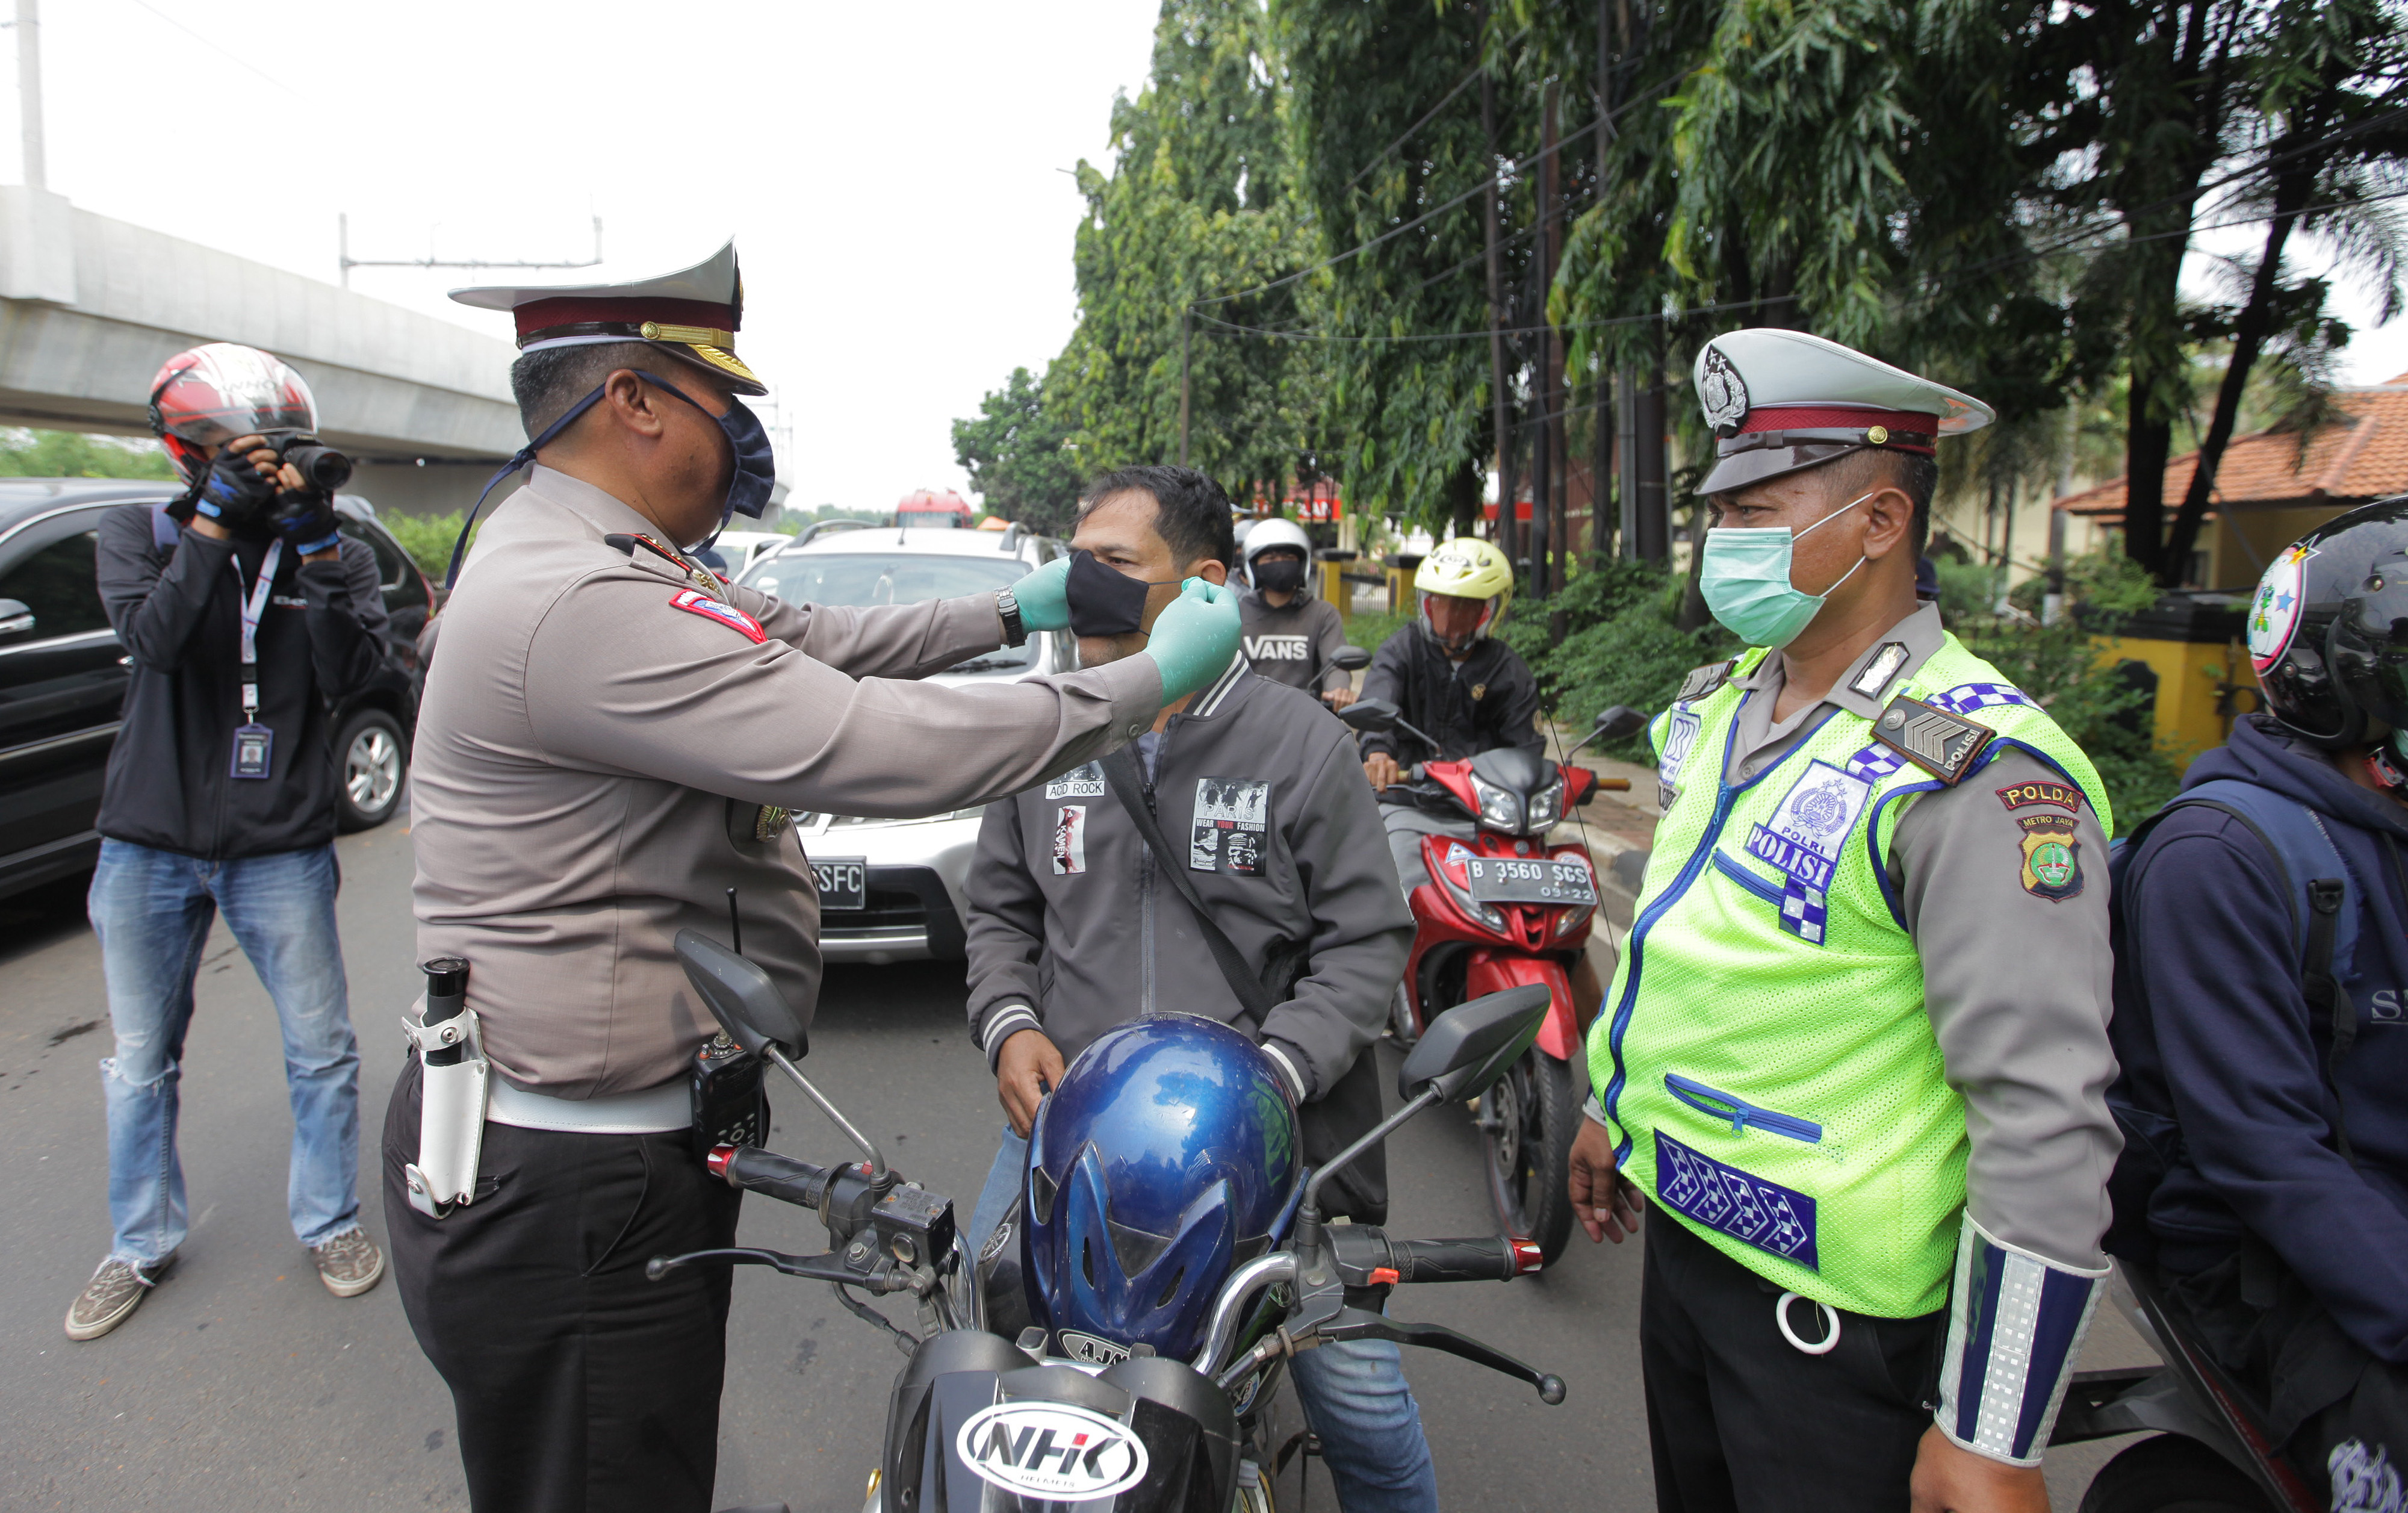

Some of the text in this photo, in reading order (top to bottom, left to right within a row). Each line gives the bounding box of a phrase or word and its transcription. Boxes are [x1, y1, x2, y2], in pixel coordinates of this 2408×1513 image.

[1243, 634, 1309, 660] VANS
[1944, 729, 1981, 771] POLISI
[1073, 782, 1103, 794] ROCK
[2006, 784, 2076, 808] POLDA
[1203, 804, 1255, 820] PARIS
[2023, 816, 2073, 827] METRO JAYA
[1196, 818, 1265, 833] WEAR YOUR FASHION
[1057, 825, 1067, 859] KAMEN
[1781, 826, 1825, 855] POLRI
[1747, 825, 1831, 888] POLISI
[819, 865, 861, 893] SFC
[1471, 861, 1485, 878] B
[1495, 862, 1542, 880] 3560
[976, 1421, 1123, 1480] NHK
